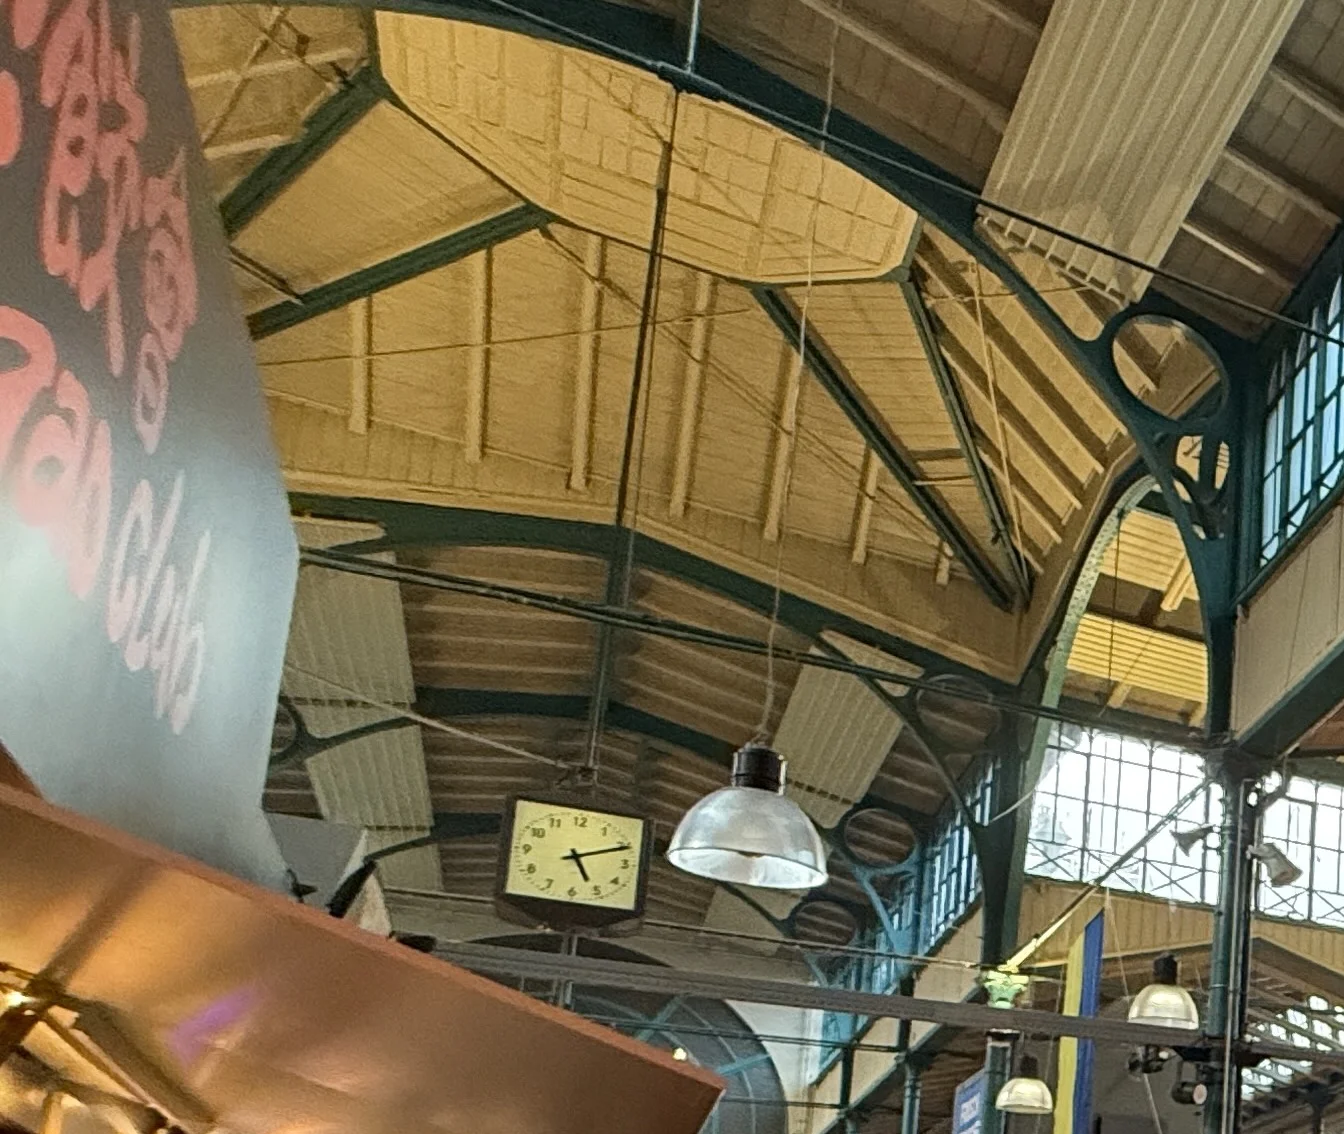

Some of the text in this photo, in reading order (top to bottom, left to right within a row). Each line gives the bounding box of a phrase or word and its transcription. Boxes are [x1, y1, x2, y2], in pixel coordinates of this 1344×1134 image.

[550, 817, 562, 828] 11
[573, 816, 588, 828] 12
[531, 827, 546, 838] 10
[601, 826, 608, 837] 1
[522, 844, 532, 854] 9
[526, 863, 537, 874] 8
[620, 859, 630, 869] 3
[545, 878, 554, 889] 7
[609, 876, 620, 885] 4
[567, 886, 577, 897] 6
[592, 885, 602, 896] 5
